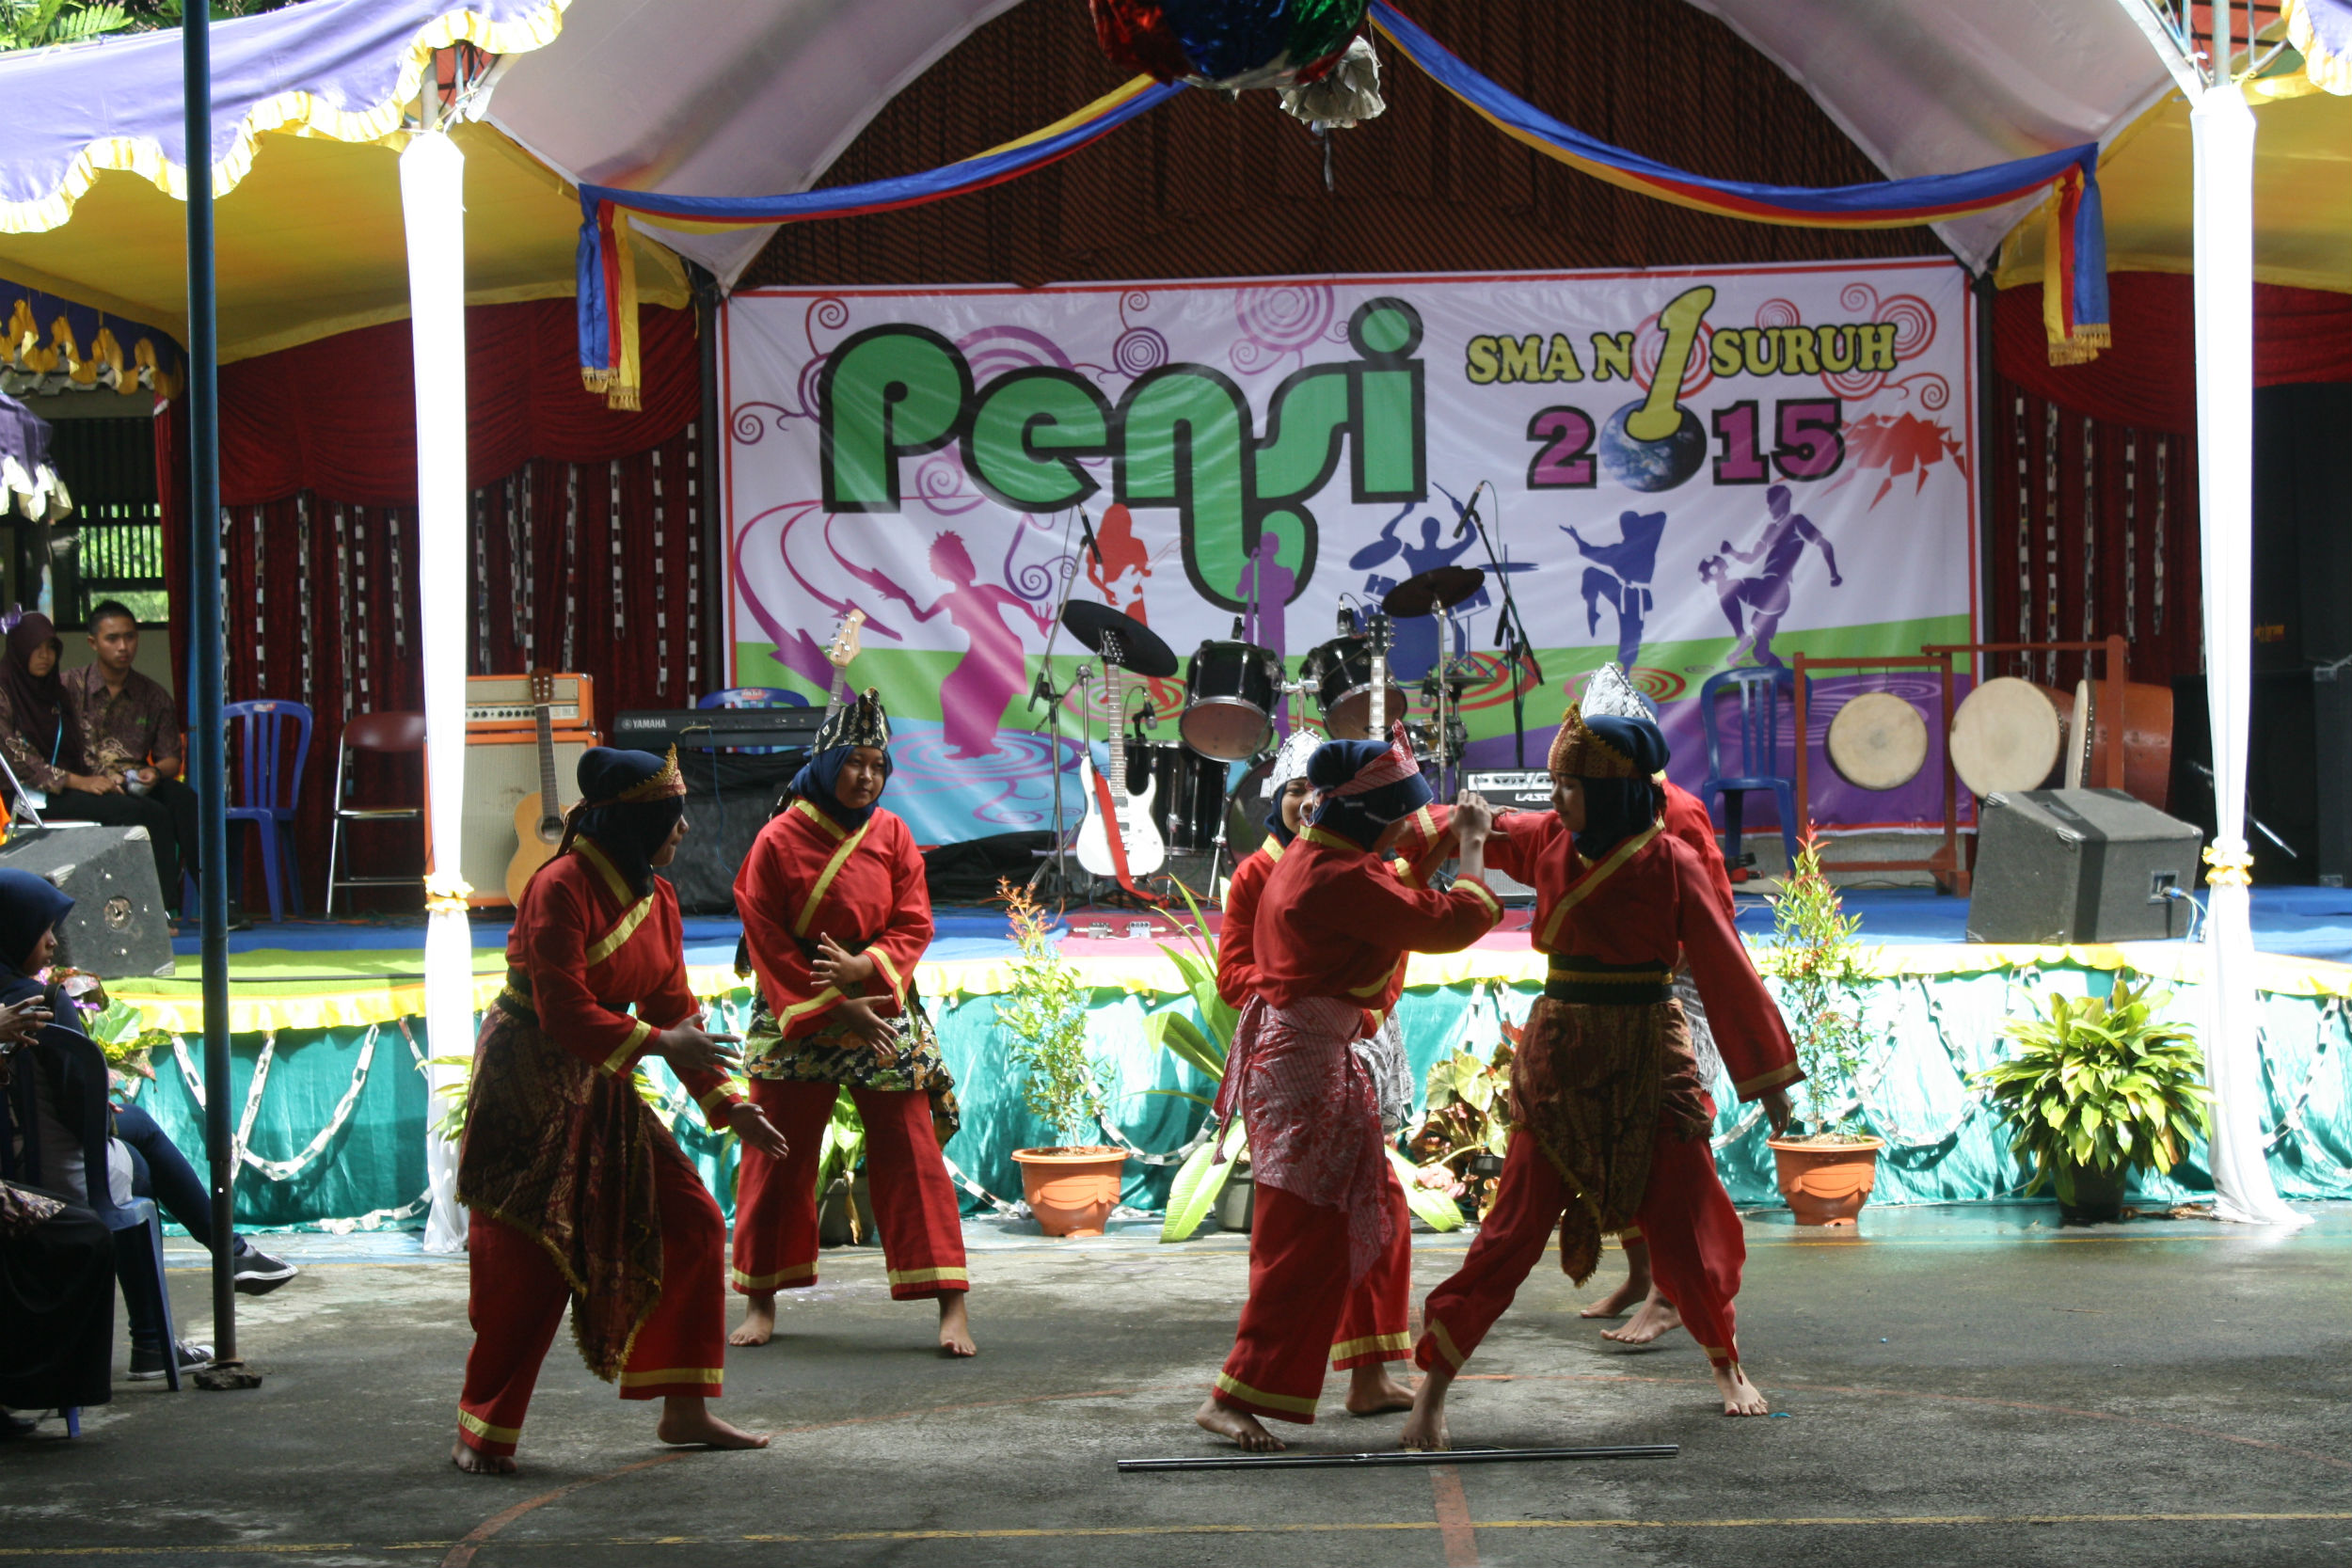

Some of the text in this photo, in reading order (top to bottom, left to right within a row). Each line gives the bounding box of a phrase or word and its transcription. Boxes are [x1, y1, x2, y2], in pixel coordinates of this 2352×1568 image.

[1466, 285, 1899, 442] SMA N 1 SURUH
[820, 296, 1426, 613] Pensi
[1526, 398, 1845, 492] 2015
[632, 719, 666, 728] YAMAHA
[1515, 793, 1552, 801] LASE
